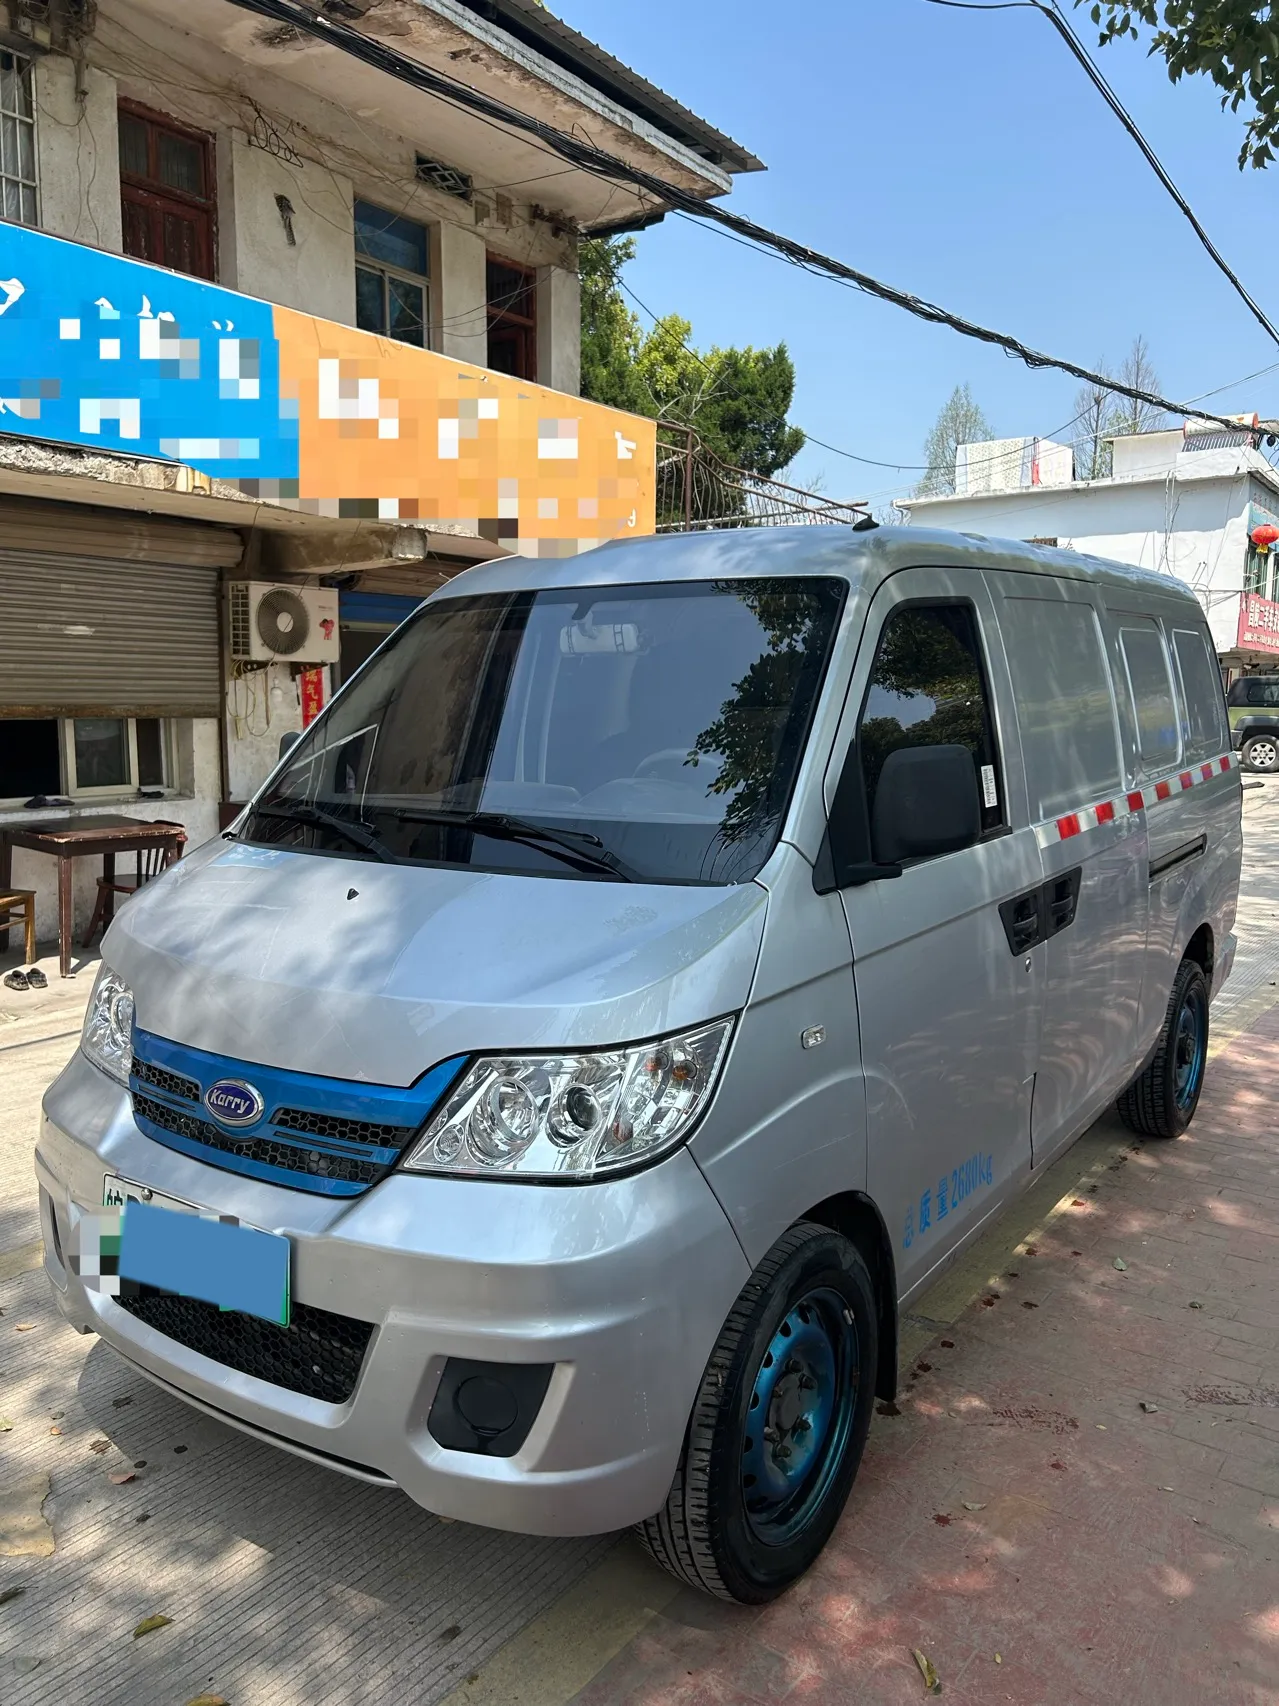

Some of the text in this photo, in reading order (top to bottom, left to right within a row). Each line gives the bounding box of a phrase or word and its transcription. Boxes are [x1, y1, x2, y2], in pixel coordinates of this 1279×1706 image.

[305, 669, 319, 723] 瑞气盈
[210, 1089, 250, 1114] Karry
